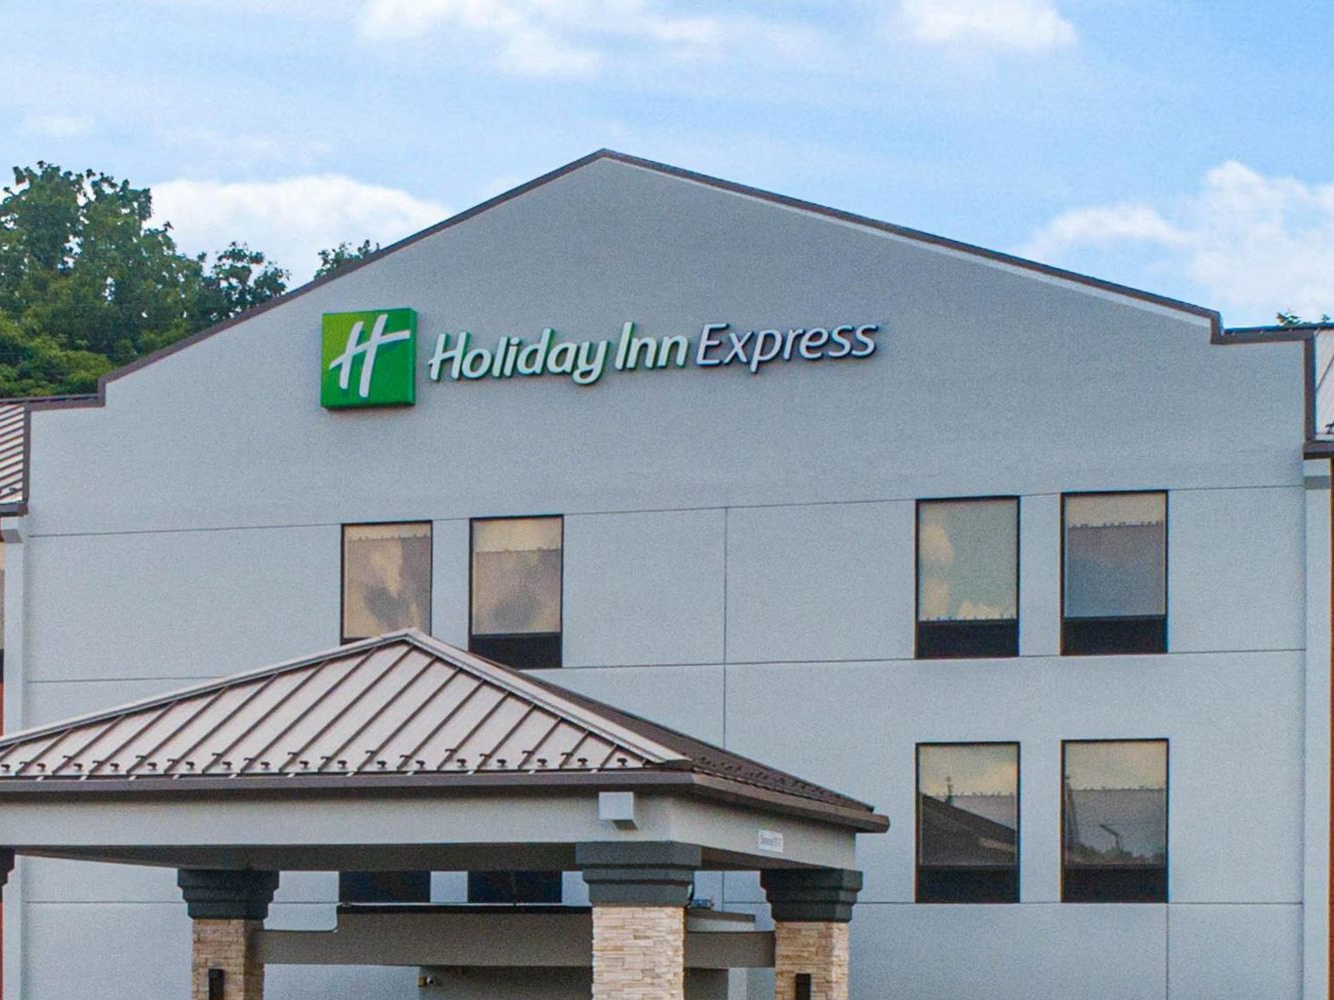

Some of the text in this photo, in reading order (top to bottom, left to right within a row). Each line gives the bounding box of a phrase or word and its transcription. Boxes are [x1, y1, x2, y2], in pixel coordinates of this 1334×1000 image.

[427, 321, 878, 386] Holiday Inn Express
